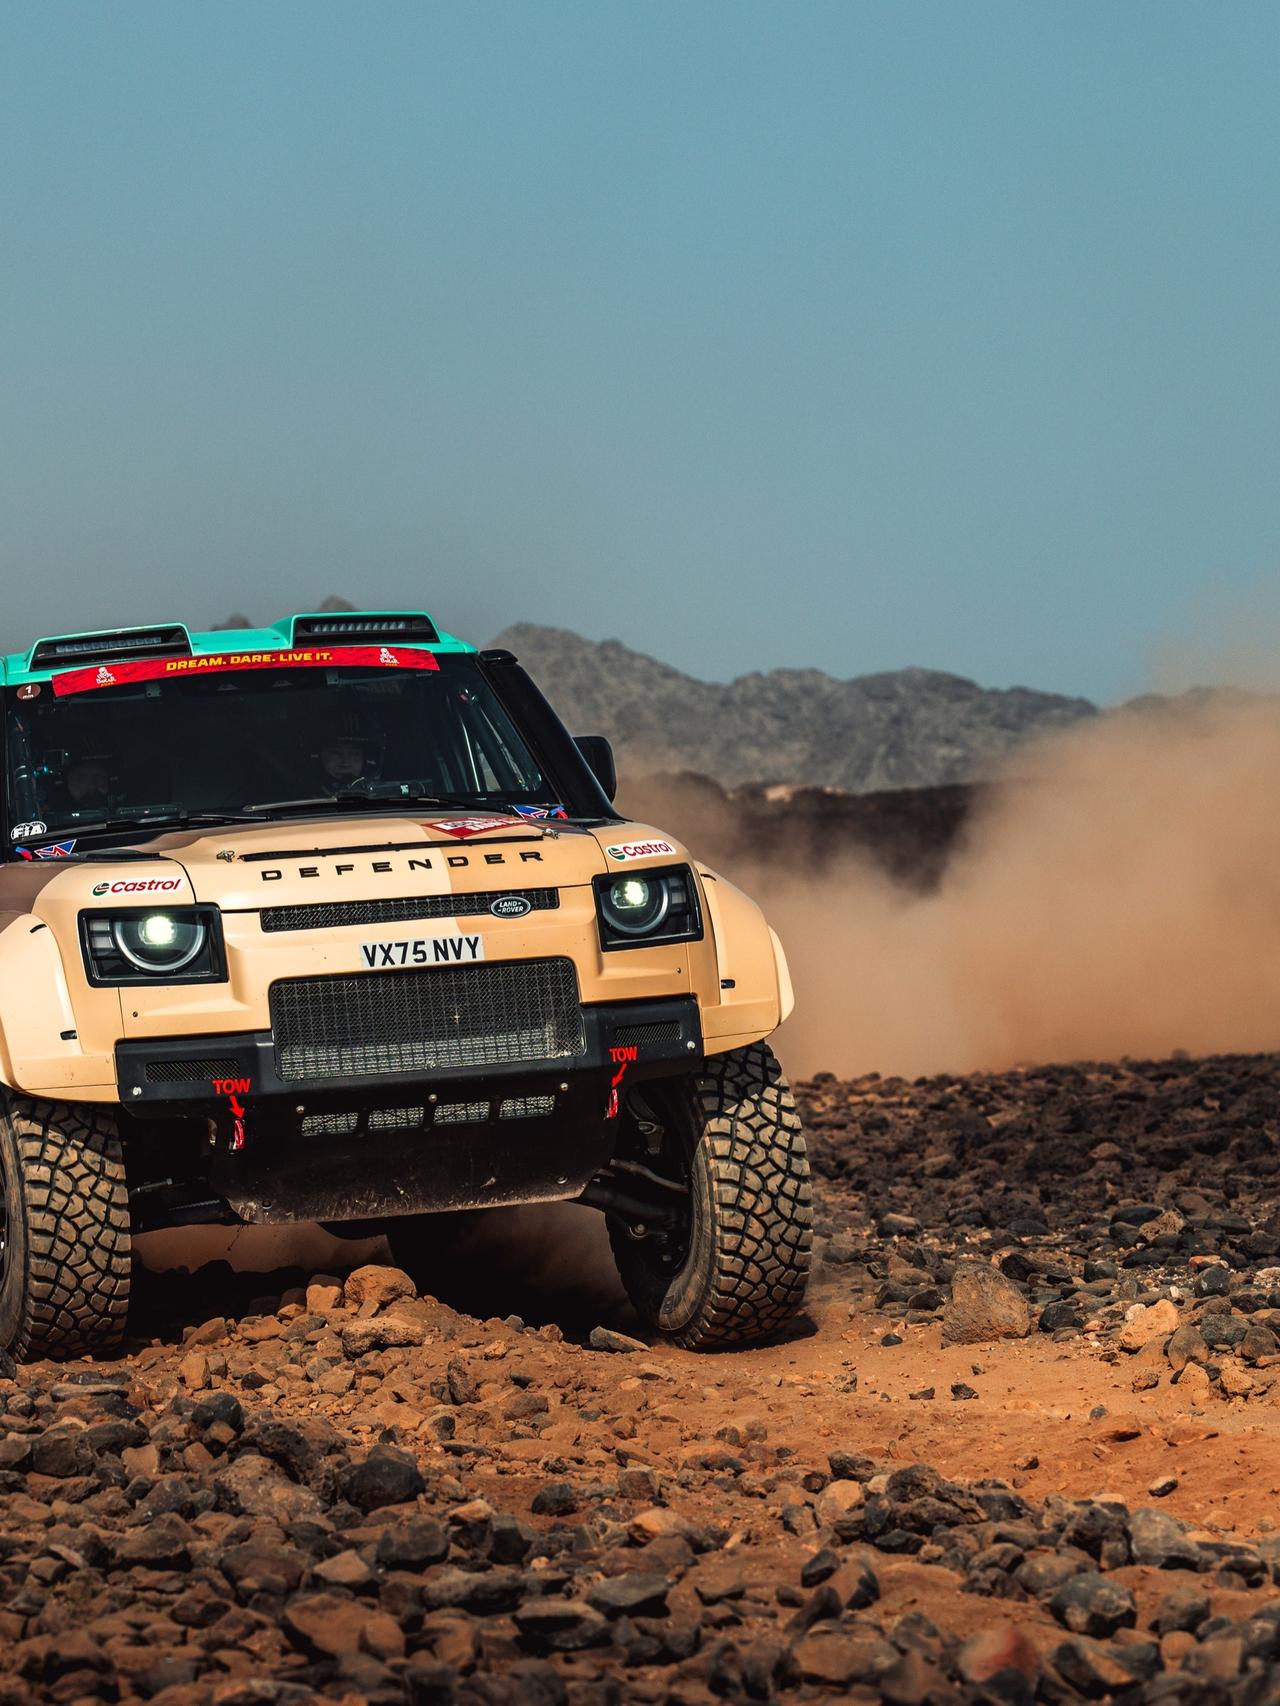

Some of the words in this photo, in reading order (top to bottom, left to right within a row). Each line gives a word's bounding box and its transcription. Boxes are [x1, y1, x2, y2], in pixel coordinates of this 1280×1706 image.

[166, 657, 226, 671] DREAM.
[230, 654, 276, 664] DARE.
[280, 652, 312, 662] LIVE
[316, 652, 333, 661] IT.
[24, 685, 32, 694] 1
[622, 842, 673, 857] Castrol
[261, 851, 544, 881] DEFENDER
[110, 879, 182, 893] Castrol
[362, 940, 427, 967] VX75
[432, 936, 479, 962] NVY
[609, 1046, 638, 1062] TOW
[212, 1078, 251, 1095] TOW
